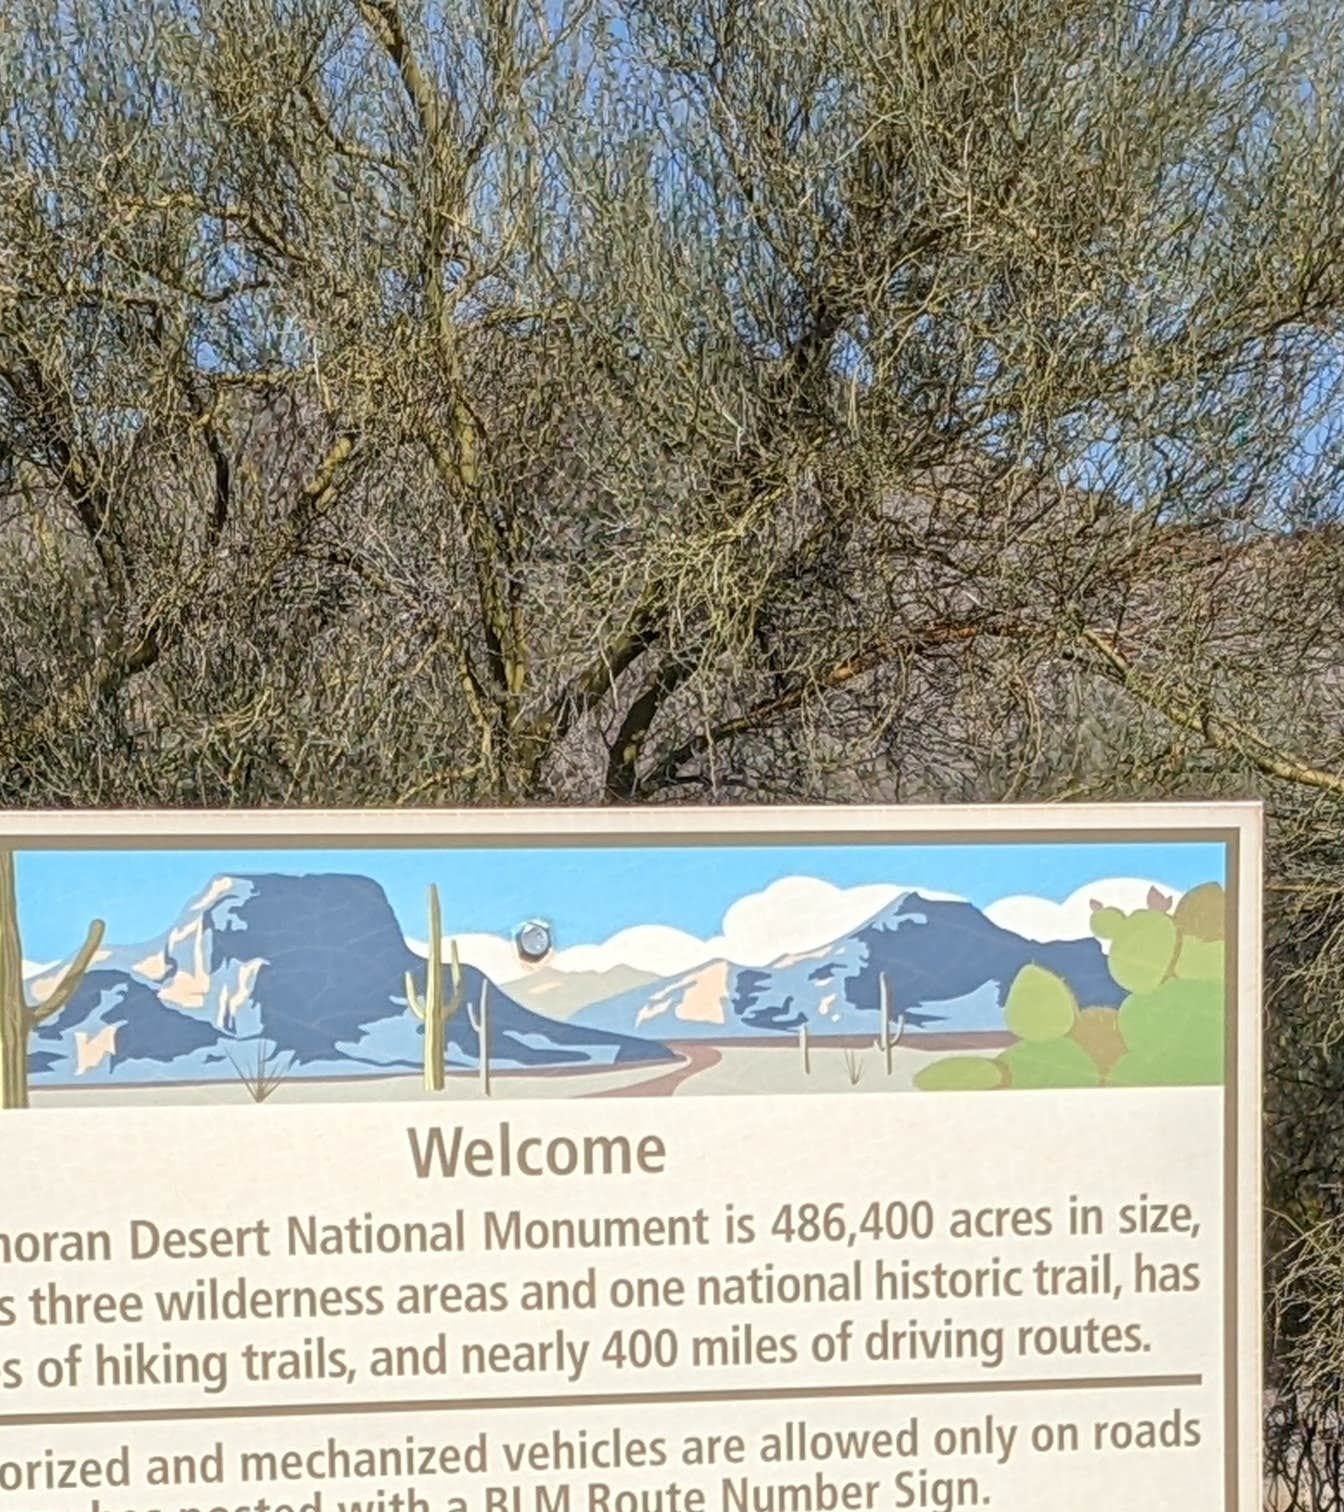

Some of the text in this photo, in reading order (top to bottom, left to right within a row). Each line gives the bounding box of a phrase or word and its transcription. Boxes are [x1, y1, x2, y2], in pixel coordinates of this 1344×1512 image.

[406, 1121, 666, 1179] Welcome
[130, 1219, 271, 1260] Desert
[287, 1209, 465, 1256] National
[484, 1208, 710, 1251] Monument
[725, 1203, 756, 1244] is
[771, 1200, 934, 1248] 486,400
[949, 1206, 1053, 1239] acres
[1069, 1194, 1103, 1235] in
[1119, 1192, 1201, 1239] size,
[28, 1282, 143, 1326] three
[154, 1276, 385, 1322] wilderness
[396, 1282, 509, 1315] areas
[520, 1267, 596, 1311] and
[610, 1277, 685, 1308] one
[698, 1259, 862, 1306] national
[875, 1256, 1023, 1301] historic
[1032, 1252, 1123, 1300] trail,
[1134, 1251, 1201, 1293] has
[146, 1441, 224, 1486] and
[240, 1432, 488, 1482] mechanized
[502, 1427, 667, 1472] vehicles
[682, 1435, 745, 1465] are
[759, 1416, 918, 1463] allowed
[933, 1414, 1018, 1465] only
[1031, 1422, 1079, 1452] on
[1094, 1407, 1201, 1450] roads
